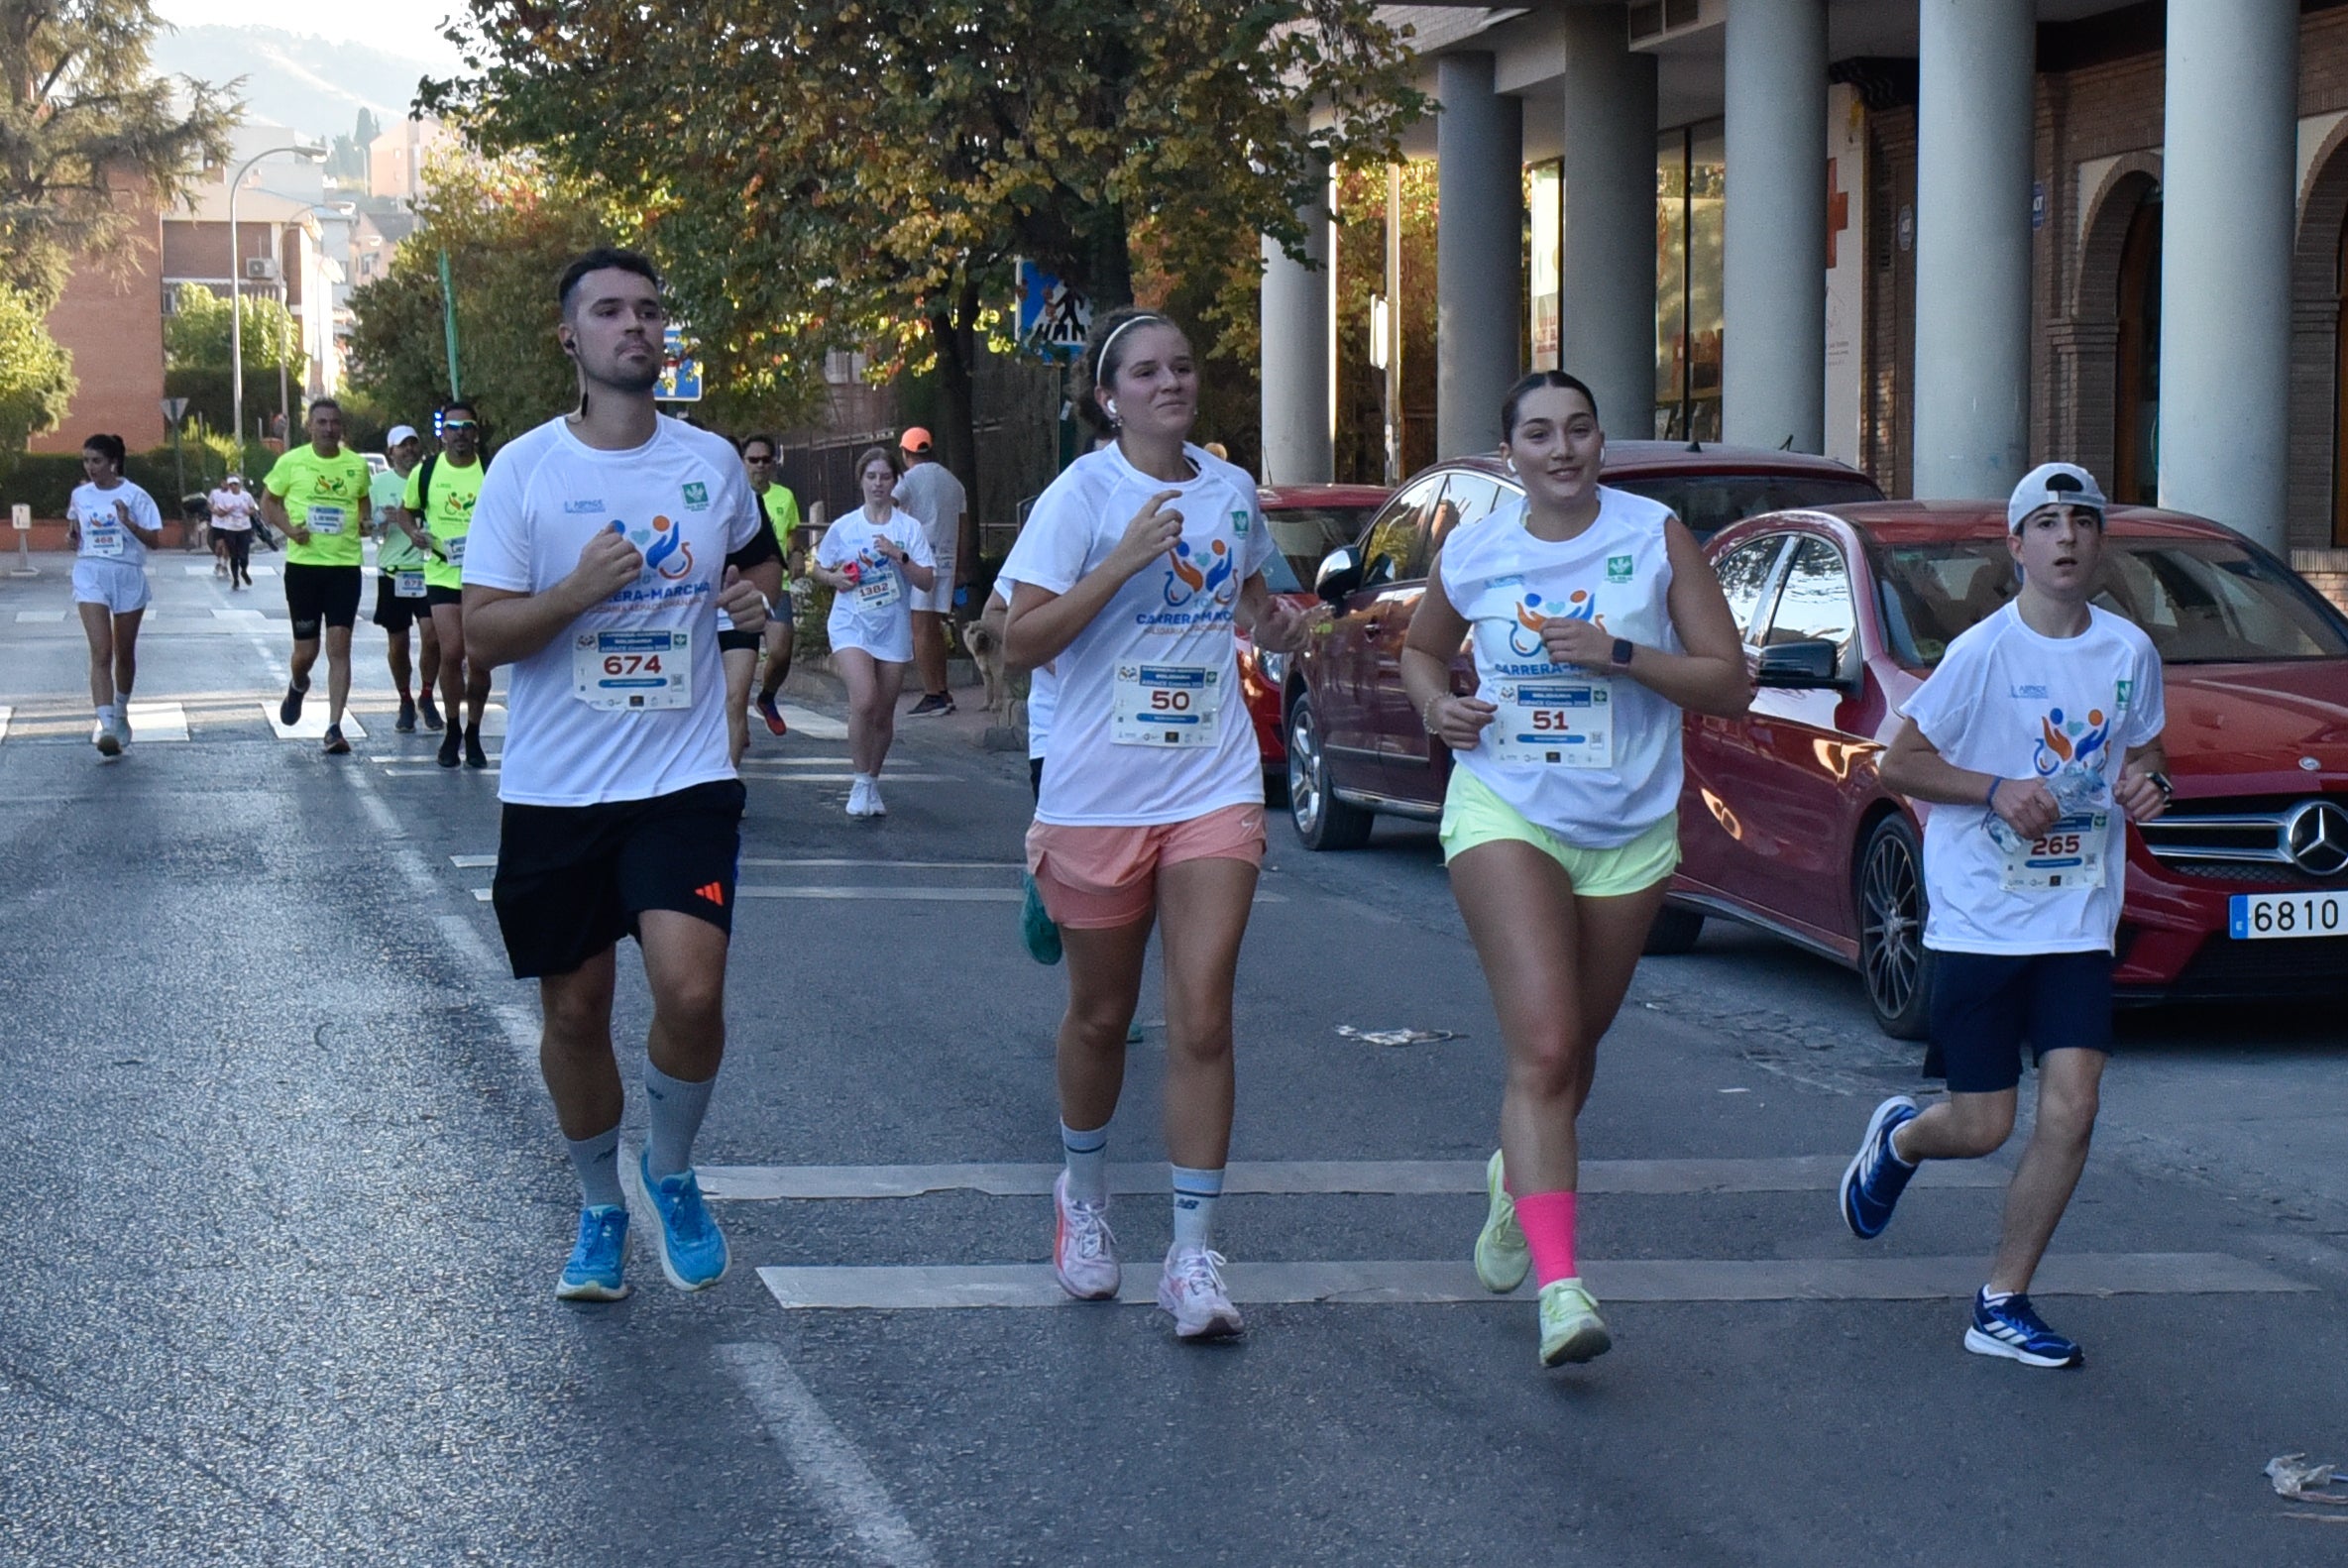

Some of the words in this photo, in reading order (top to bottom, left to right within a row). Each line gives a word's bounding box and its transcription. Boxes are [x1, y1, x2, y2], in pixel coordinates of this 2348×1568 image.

[859, 582, 890, 598] 1382
[604, 654, 662, 676] 674
[1151, 690, 1190, 712] 50
[1532, 710, 1569, 730] 51
[2030, 835, 2080, 856] 265
[2254, 899, 2339, 933] 6810
